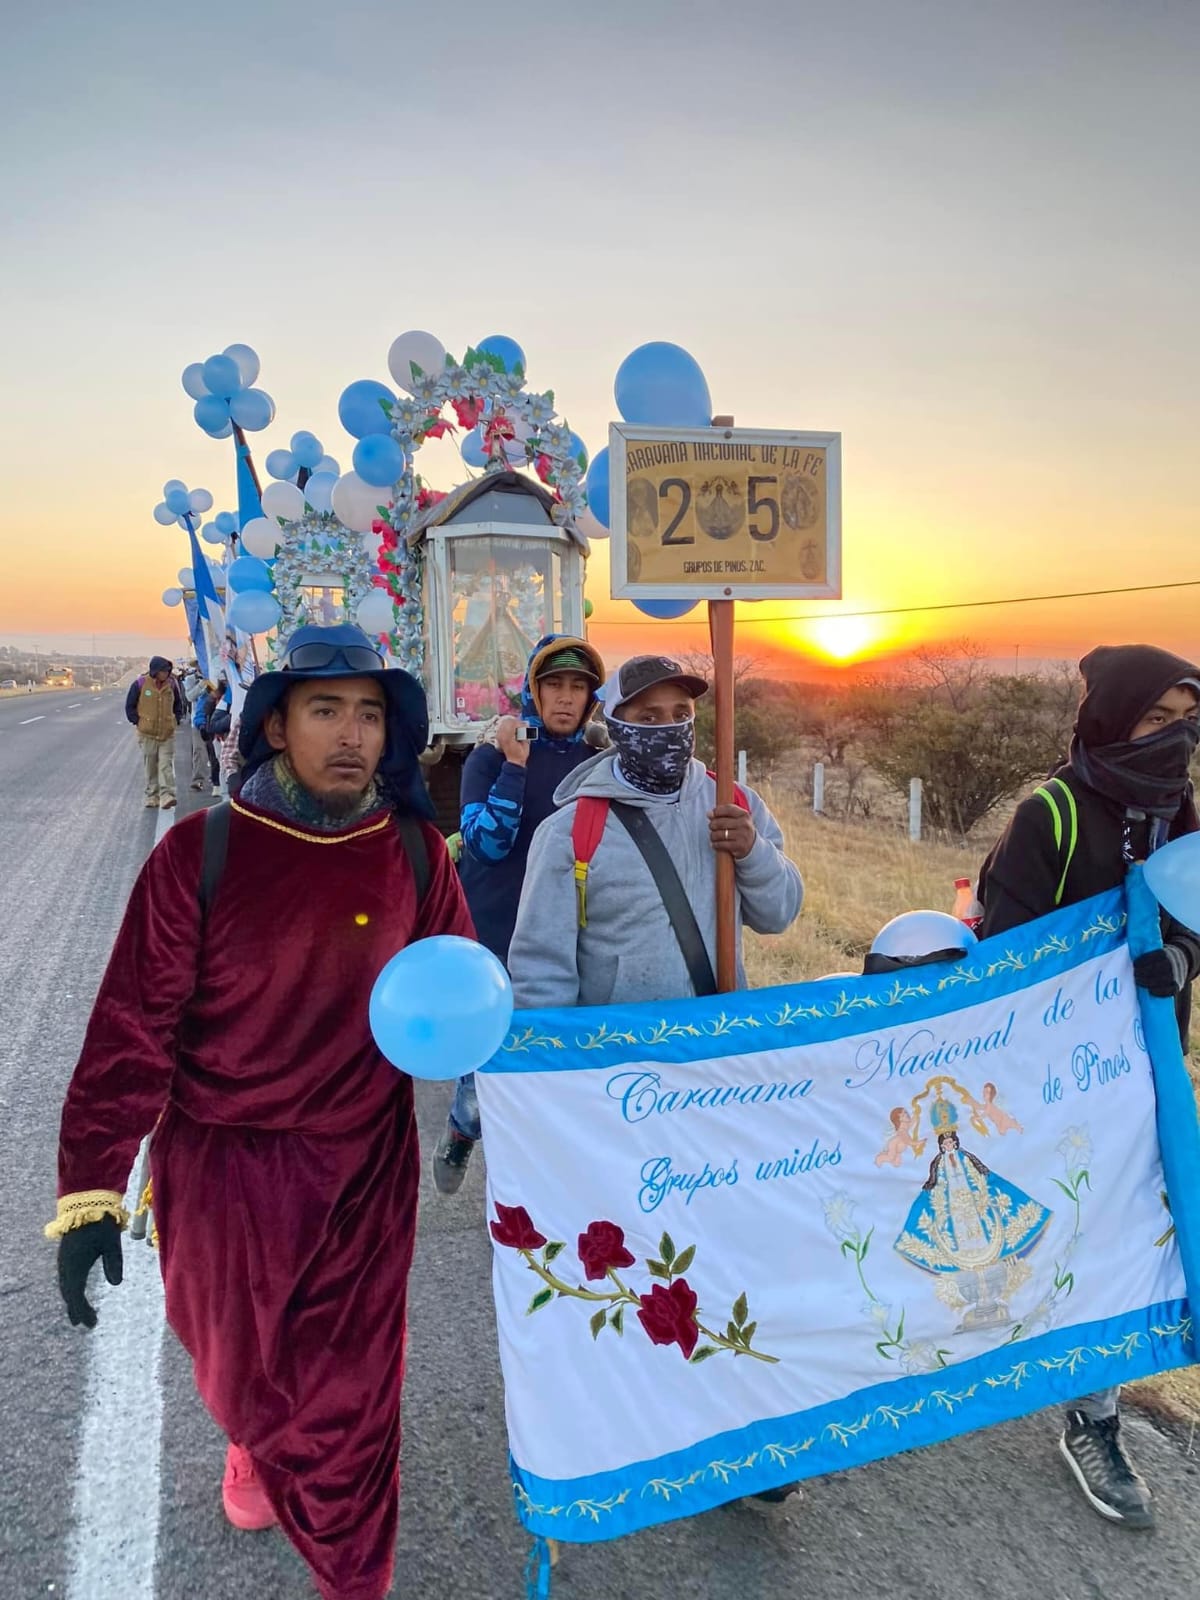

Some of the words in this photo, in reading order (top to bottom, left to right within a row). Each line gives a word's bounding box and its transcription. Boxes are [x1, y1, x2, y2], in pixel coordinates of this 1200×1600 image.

[694, 442, 756, 462] NACIONAL
[761, 445, 777, 464] DE
[781, 447, 800, 469] LA
[803, 453, 823, 476] FE
[683, 560, 713, 573] GRUPOS
[713, 560, 724, 573] DE
[606, 1072, 813, 1123] Caravana
[845, 1011, 1016, 1088] Nacional
[1043, 987, 1075, 1027] de
[1095, 970, 1121, 1005] la
[638, 1157, 739, 1213] Grupos
[755, 1139, 842, 1181] unidos
[1043, 1063, 1063, 1105] de
[1072, 1042, 1131, 1091] Pinos
